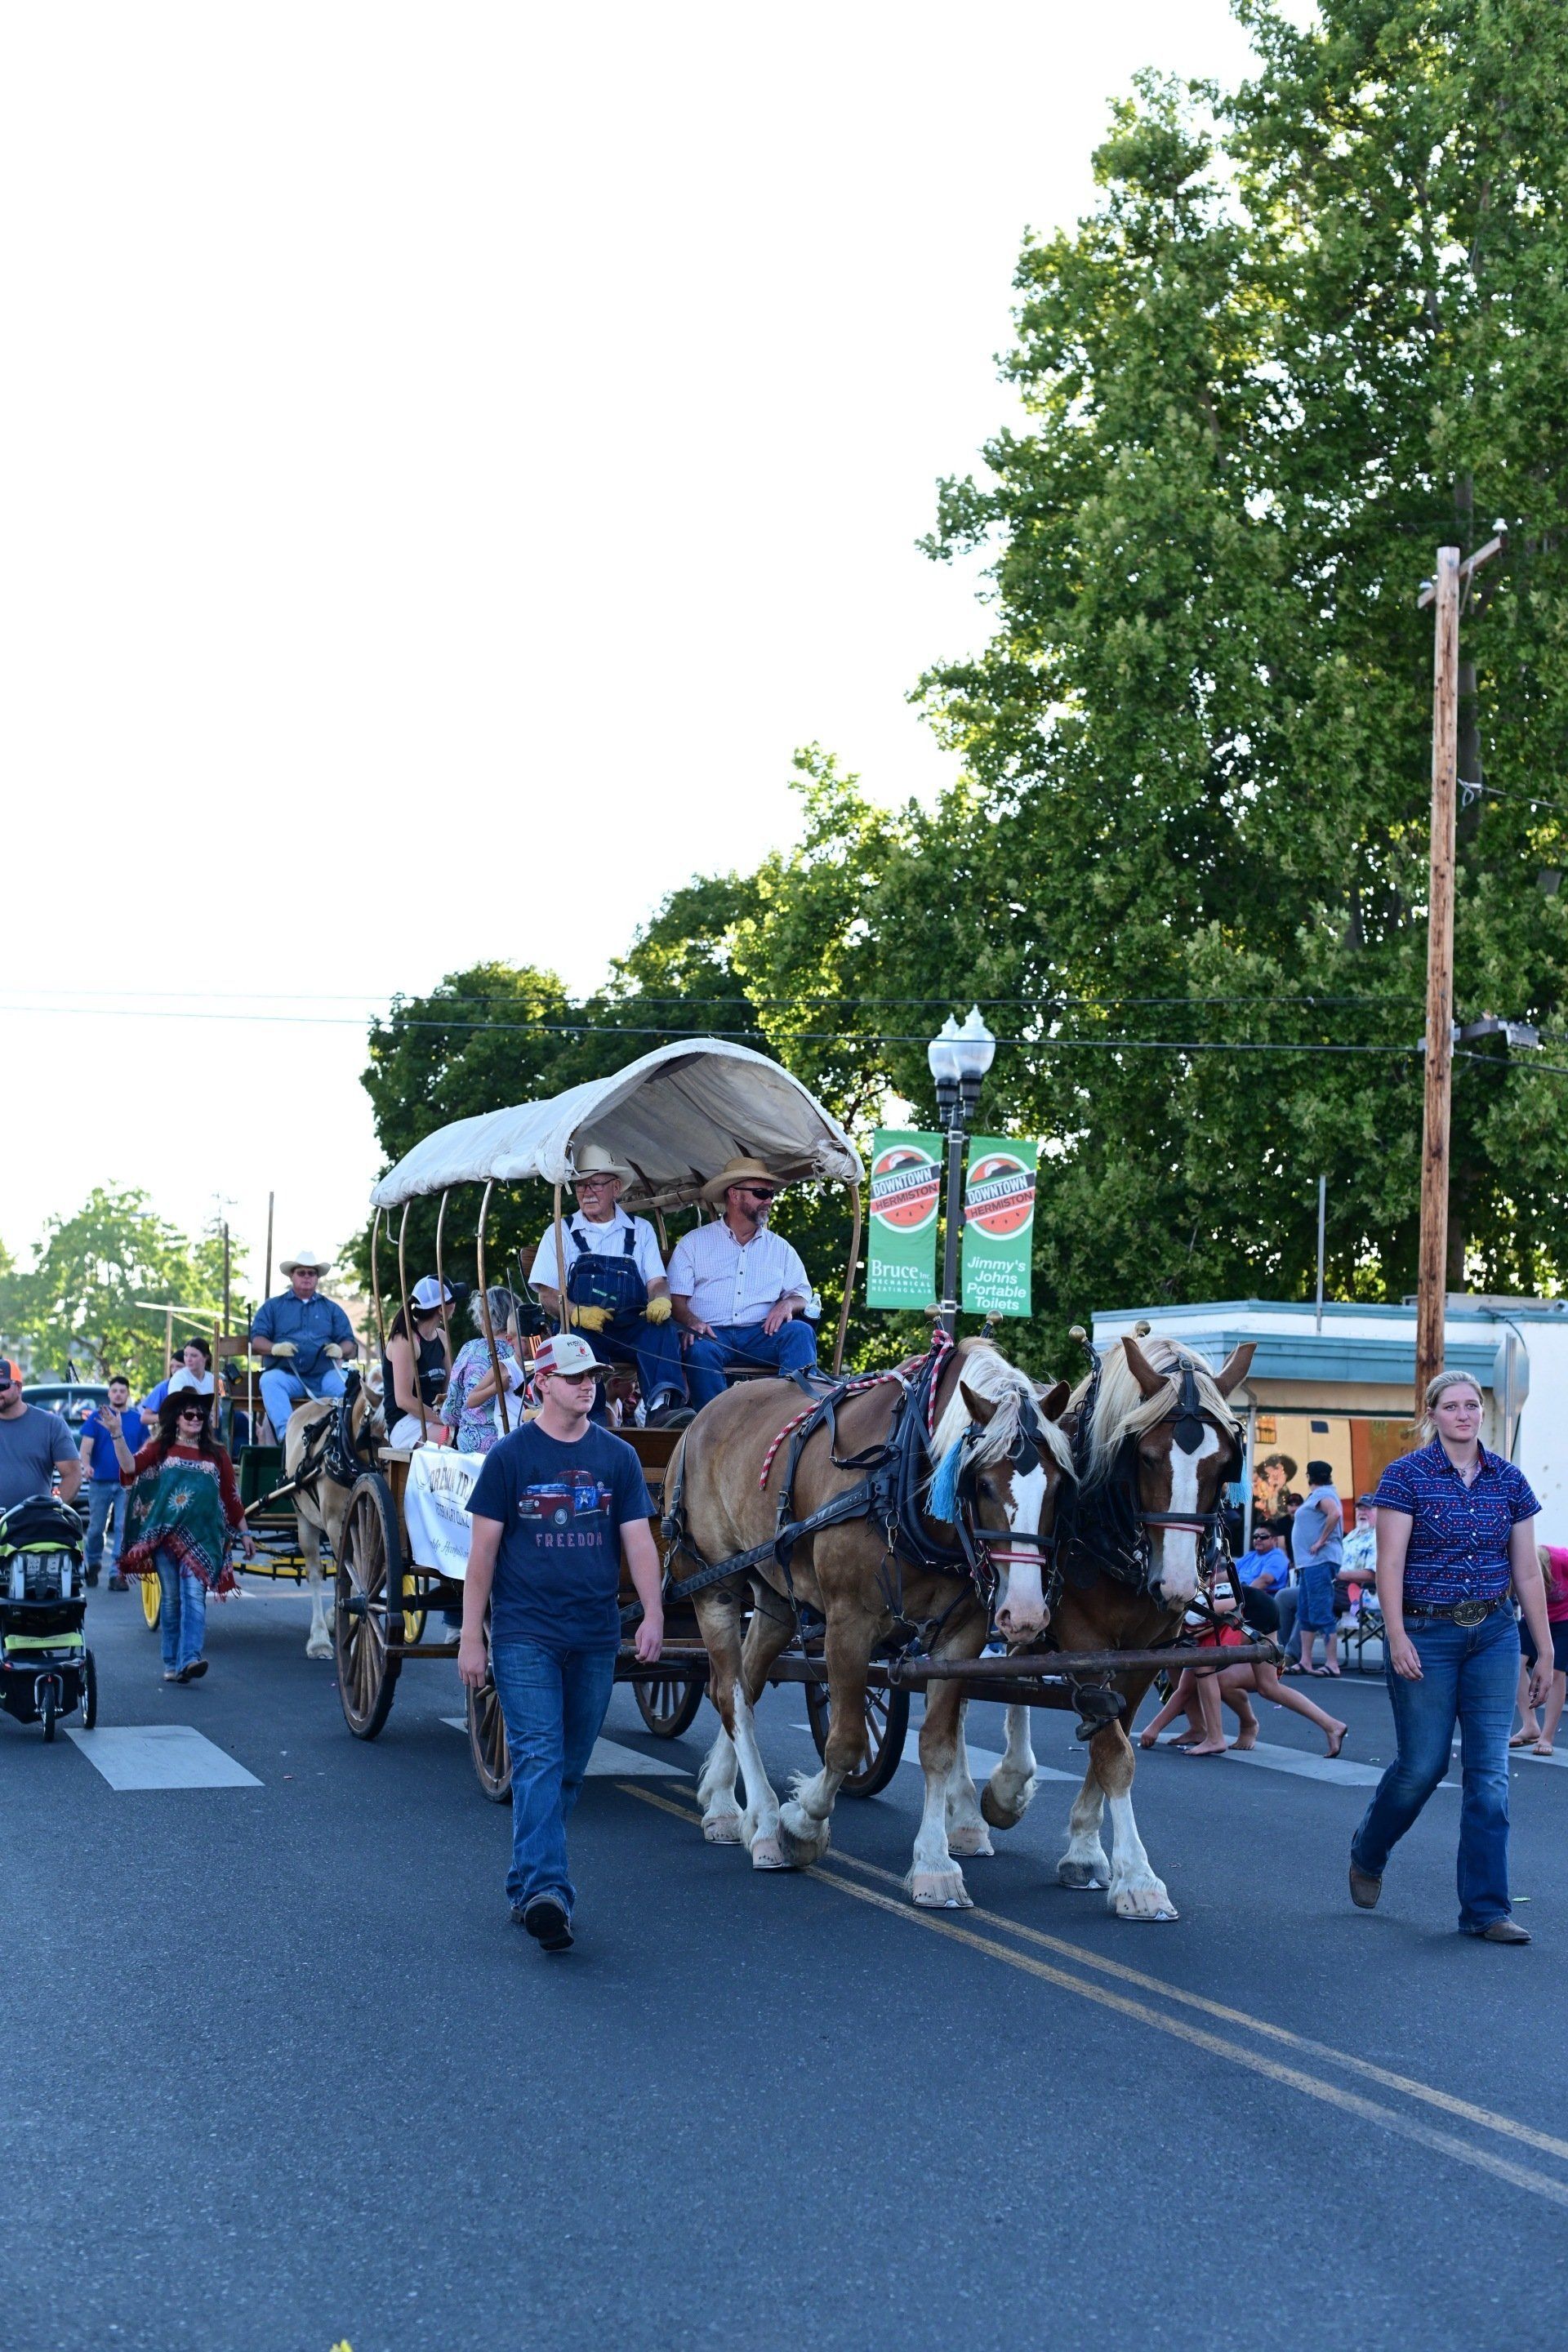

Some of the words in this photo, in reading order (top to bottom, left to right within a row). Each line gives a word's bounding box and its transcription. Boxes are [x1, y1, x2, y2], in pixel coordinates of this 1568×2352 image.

[873, 1168, 933, 1198] DOWNTOWN
[967, 1175, 1028, 1205] DOWNTOWN
[876, 1183, 938, 1210] HERMISTON
[970, 1191, 1033, 1218] HERMISTON
[871, 1259, 919, 1280] Bruce
[920, 1272, 933, 1281] Inc.
[967, 1256, 1027, 1274] Jimmy's
[871, 1278, 931, 1288] MECHANICAL
[974, 1270, 1018, 1285] Johns
[871, 1285, 908, 1294] HEATING
[966, 1282, 1027, 1298] Portable
[974, 1295, 1019, 1311] Toilets
[535, 1531, 603, 1548] FREEDOM
